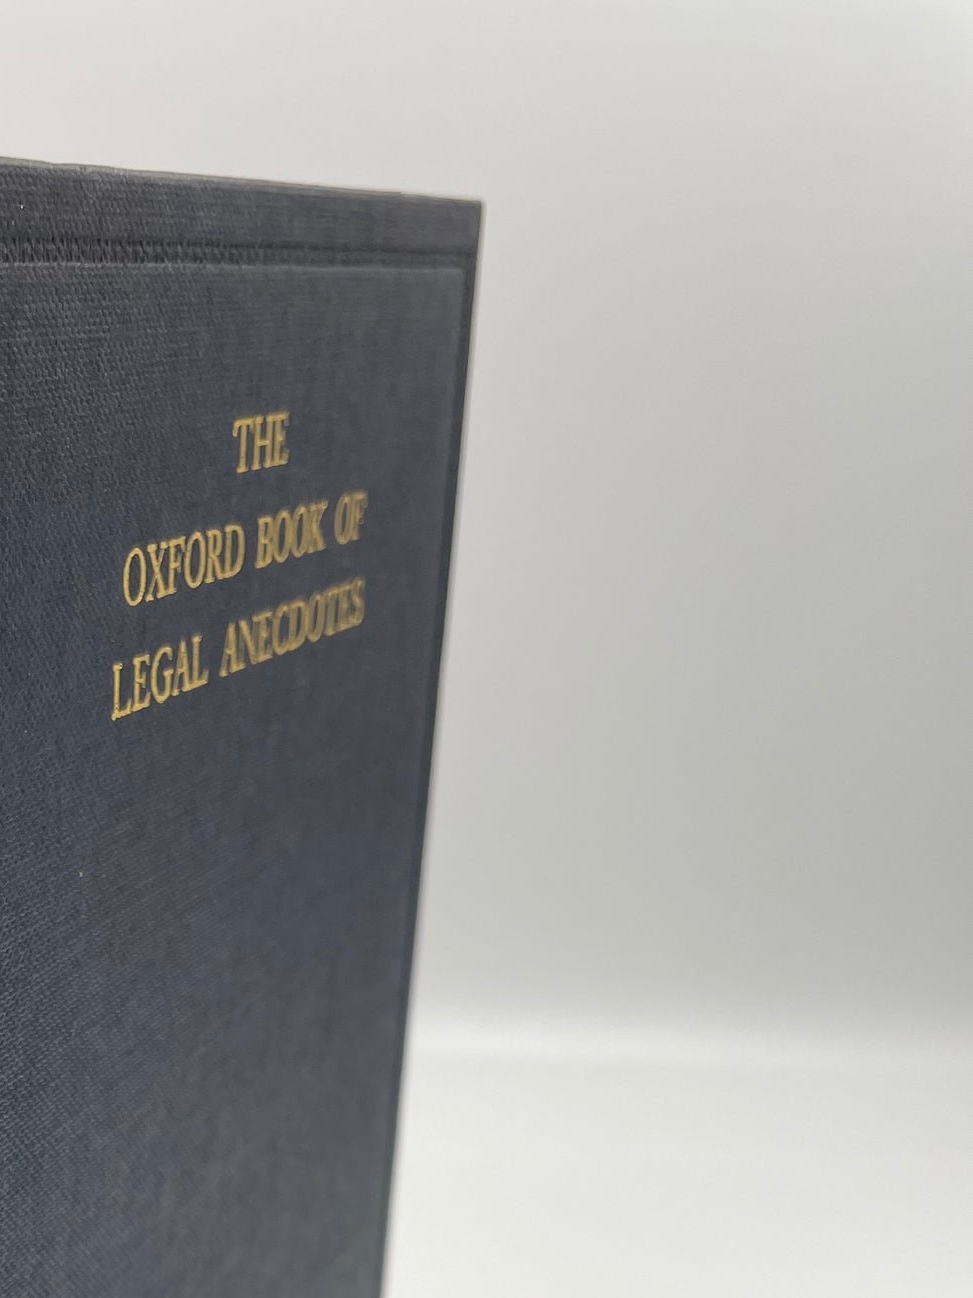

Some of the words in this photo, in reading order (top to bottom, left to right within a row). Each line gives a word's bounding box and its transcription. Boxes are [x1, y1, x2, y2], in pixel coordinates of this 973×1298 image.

[232, 411, 290, 473] THE
[122, 524, 246, 606] OXFORD
[255, 501, 328, 568] BOOK
[334, 491, 368, 545] OF
[111, 634, 209, 720] LEGAL
[218, 576, 365, 677] ANECDOTES
